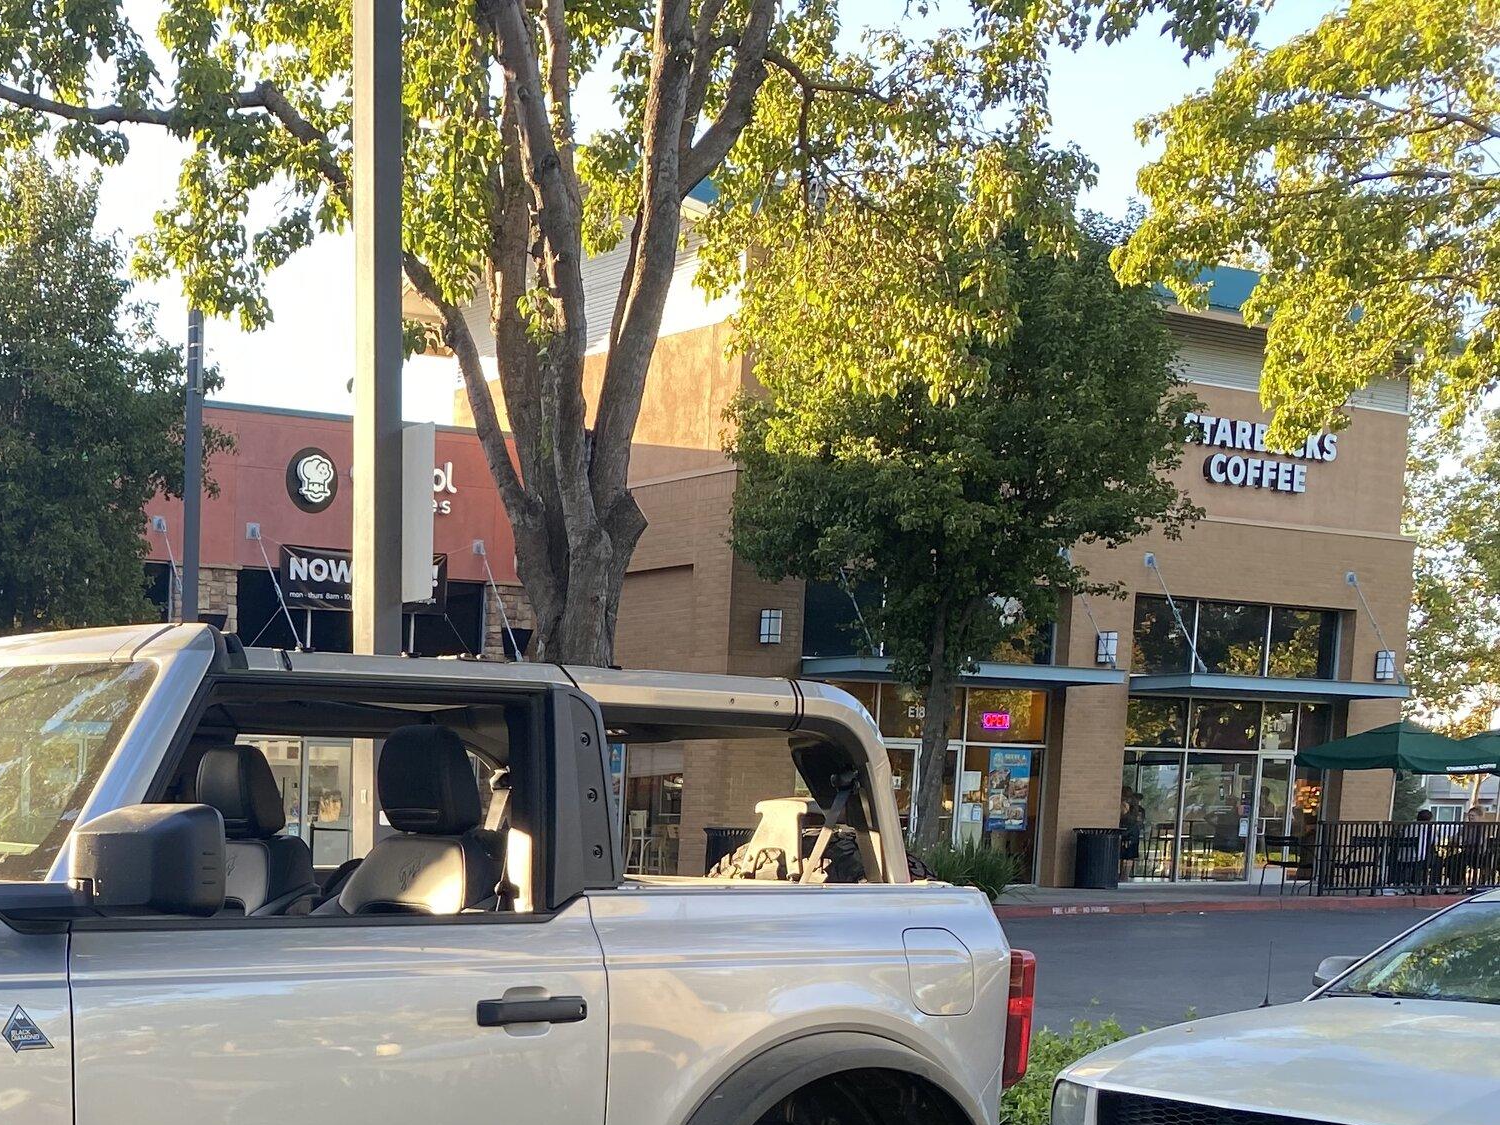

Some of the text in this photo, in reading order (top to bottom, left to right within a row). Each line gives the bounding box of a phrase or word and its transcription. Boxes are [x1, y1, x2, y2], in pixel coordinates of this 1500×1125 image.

[1206, 452, 1308, 493] COFFEE
[289, 557, 353, 583] NOW
[908, 706, 926, 718] E18
